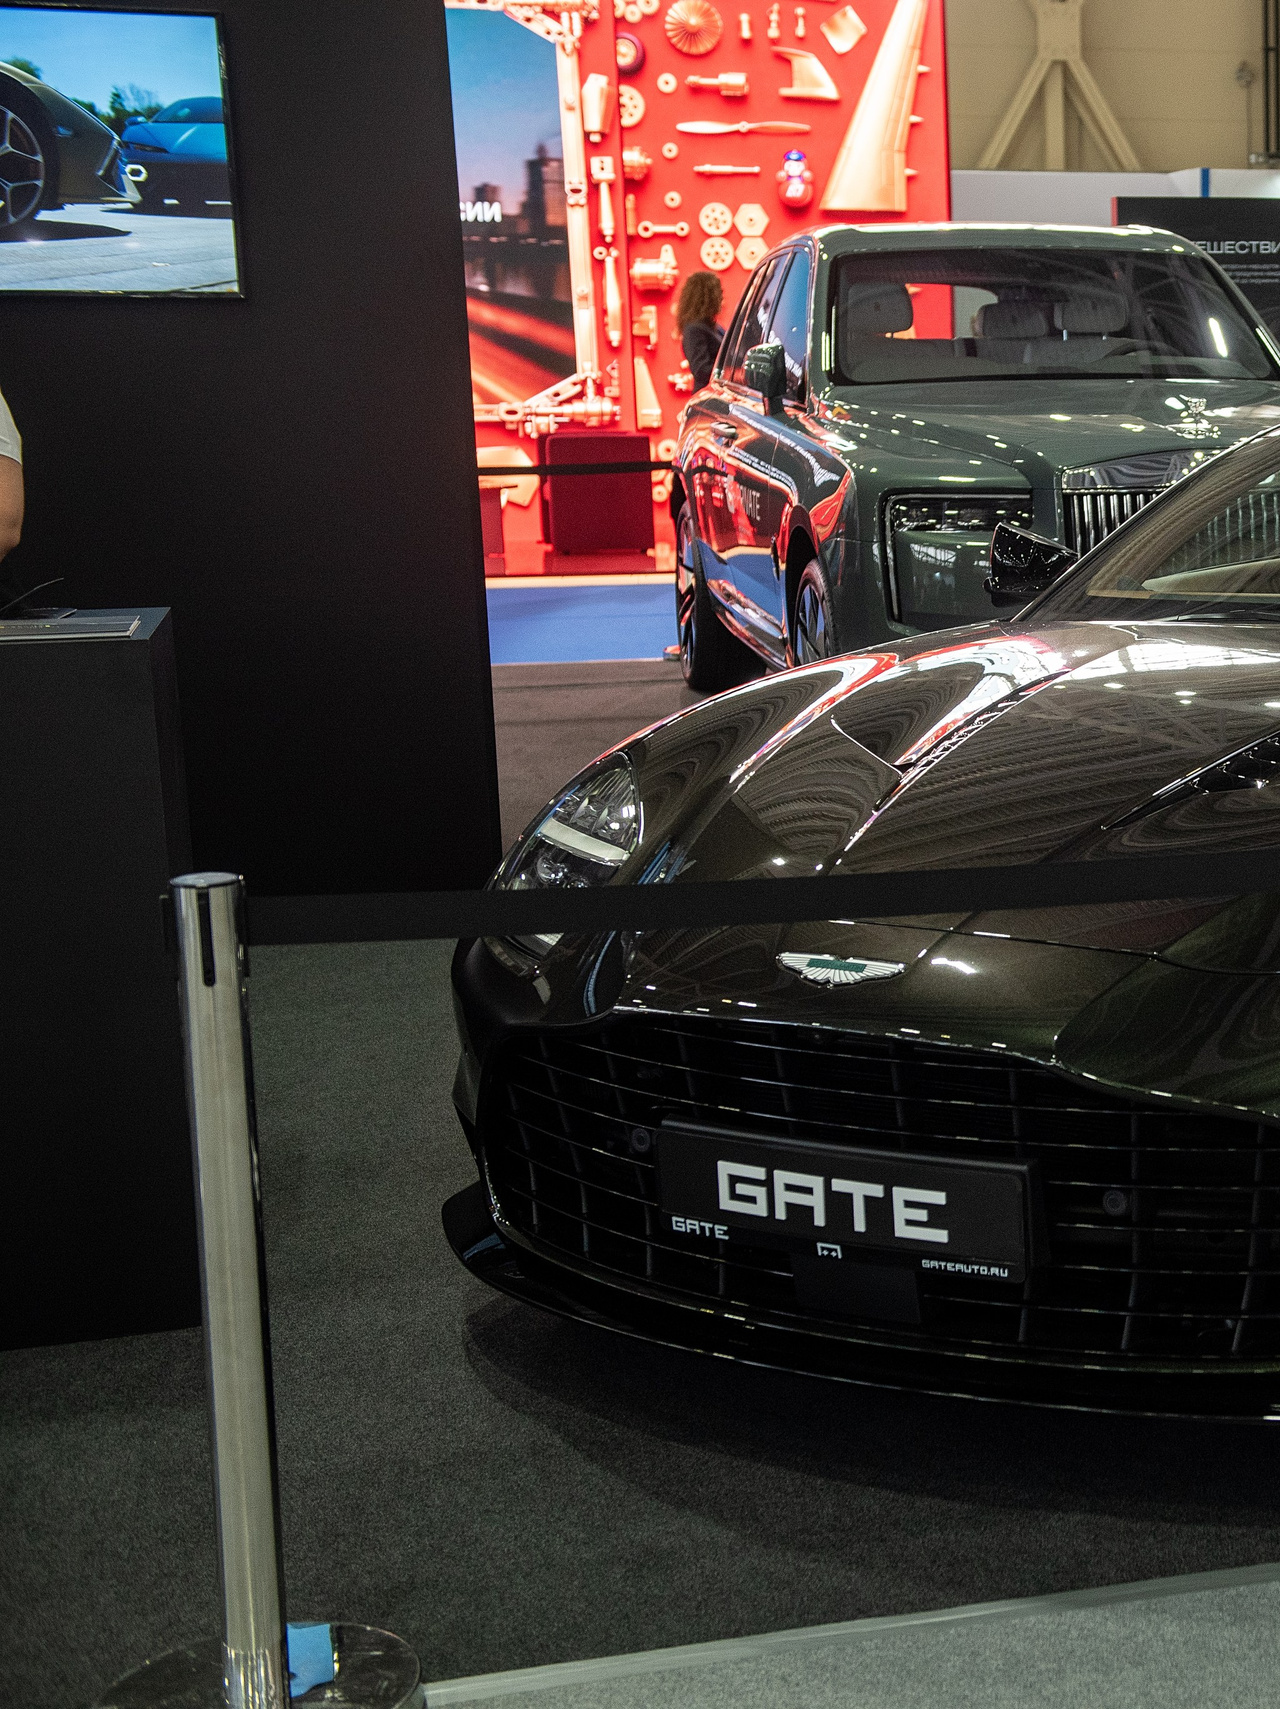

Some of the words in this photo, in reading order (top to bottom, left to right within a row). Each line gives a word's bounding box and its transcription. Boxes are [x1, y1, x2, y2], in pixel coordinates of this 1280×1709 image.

[717, 1160, 949, 1244] GATE
[671, 1216, 730, 1240] GATE
[921, 1259, 1009, 1278] GATEAUTO.RU
